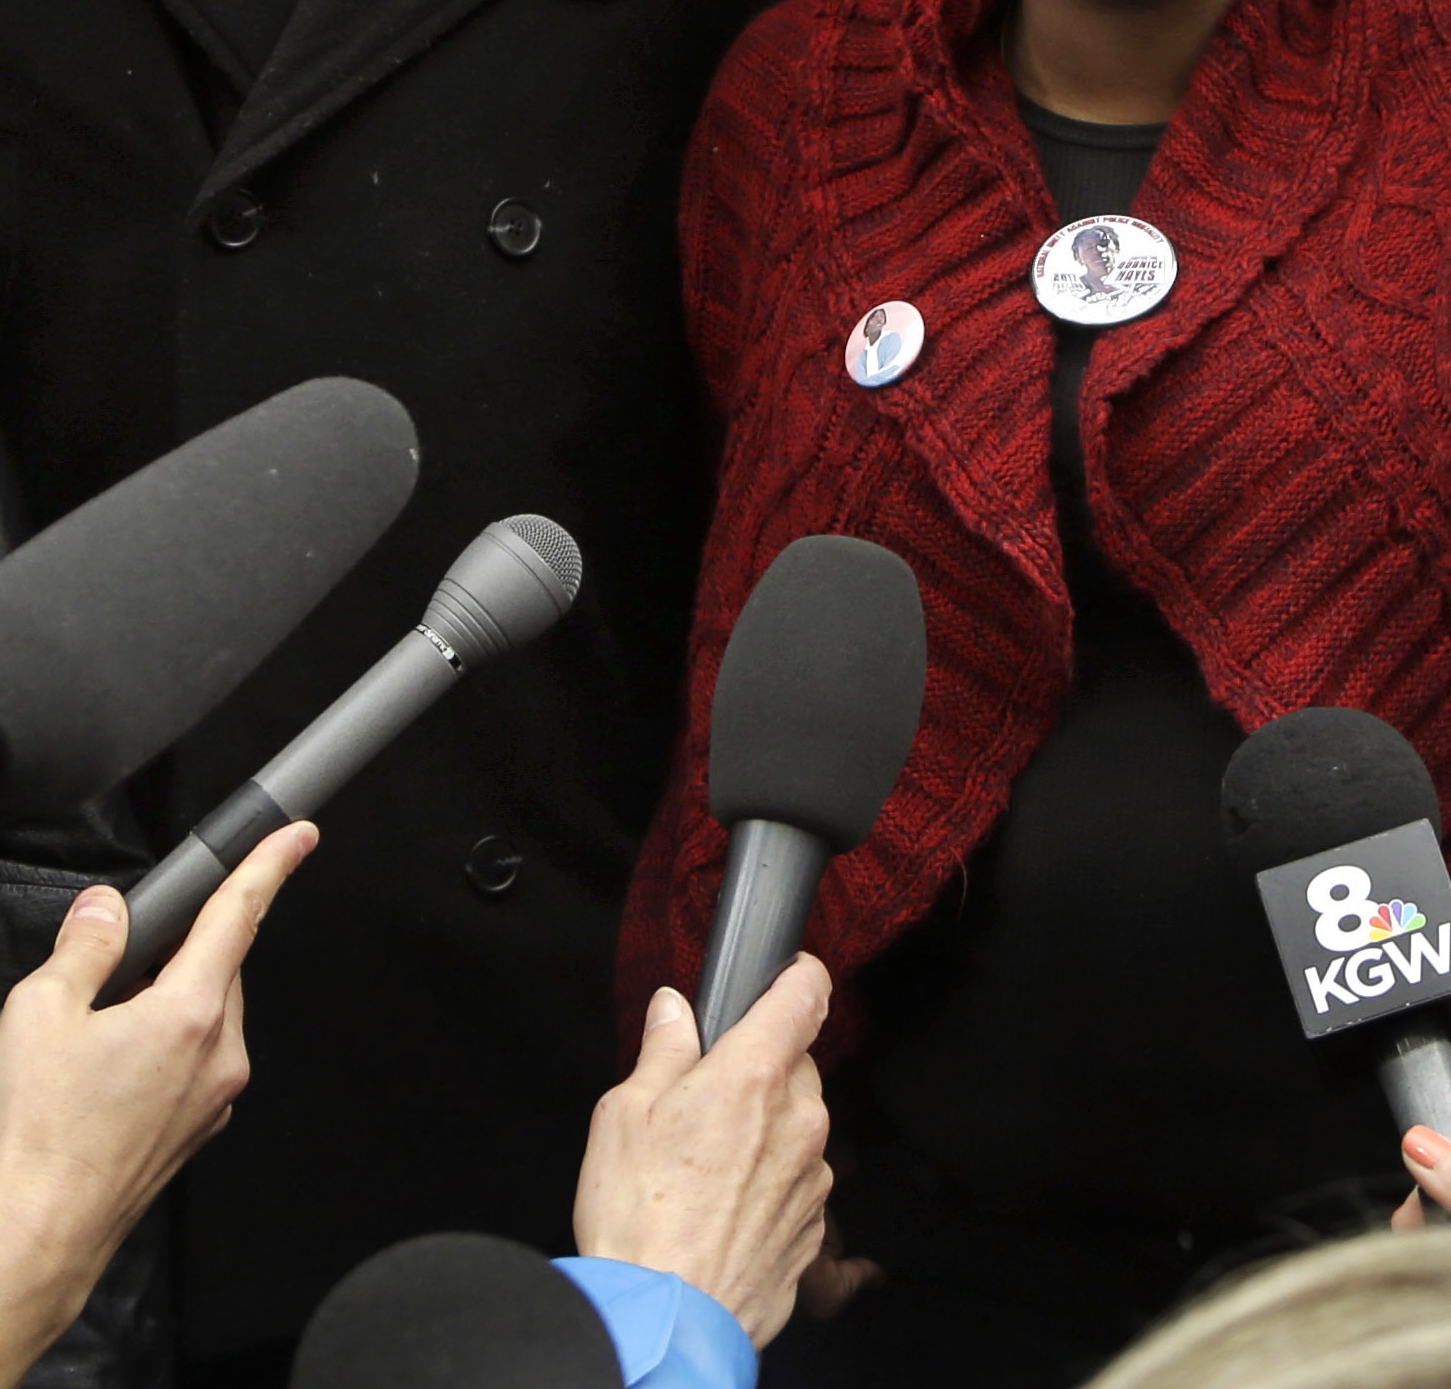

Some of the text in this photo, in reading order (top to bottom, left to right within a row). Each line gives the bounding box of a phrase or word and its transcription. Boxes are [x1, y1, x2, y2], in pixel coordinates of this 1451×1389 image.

[1116, 270, 1155, 281] HAYES
[1307, 865, 1378, 952] 8
[1304, 922, 1451, 1014] KGW
